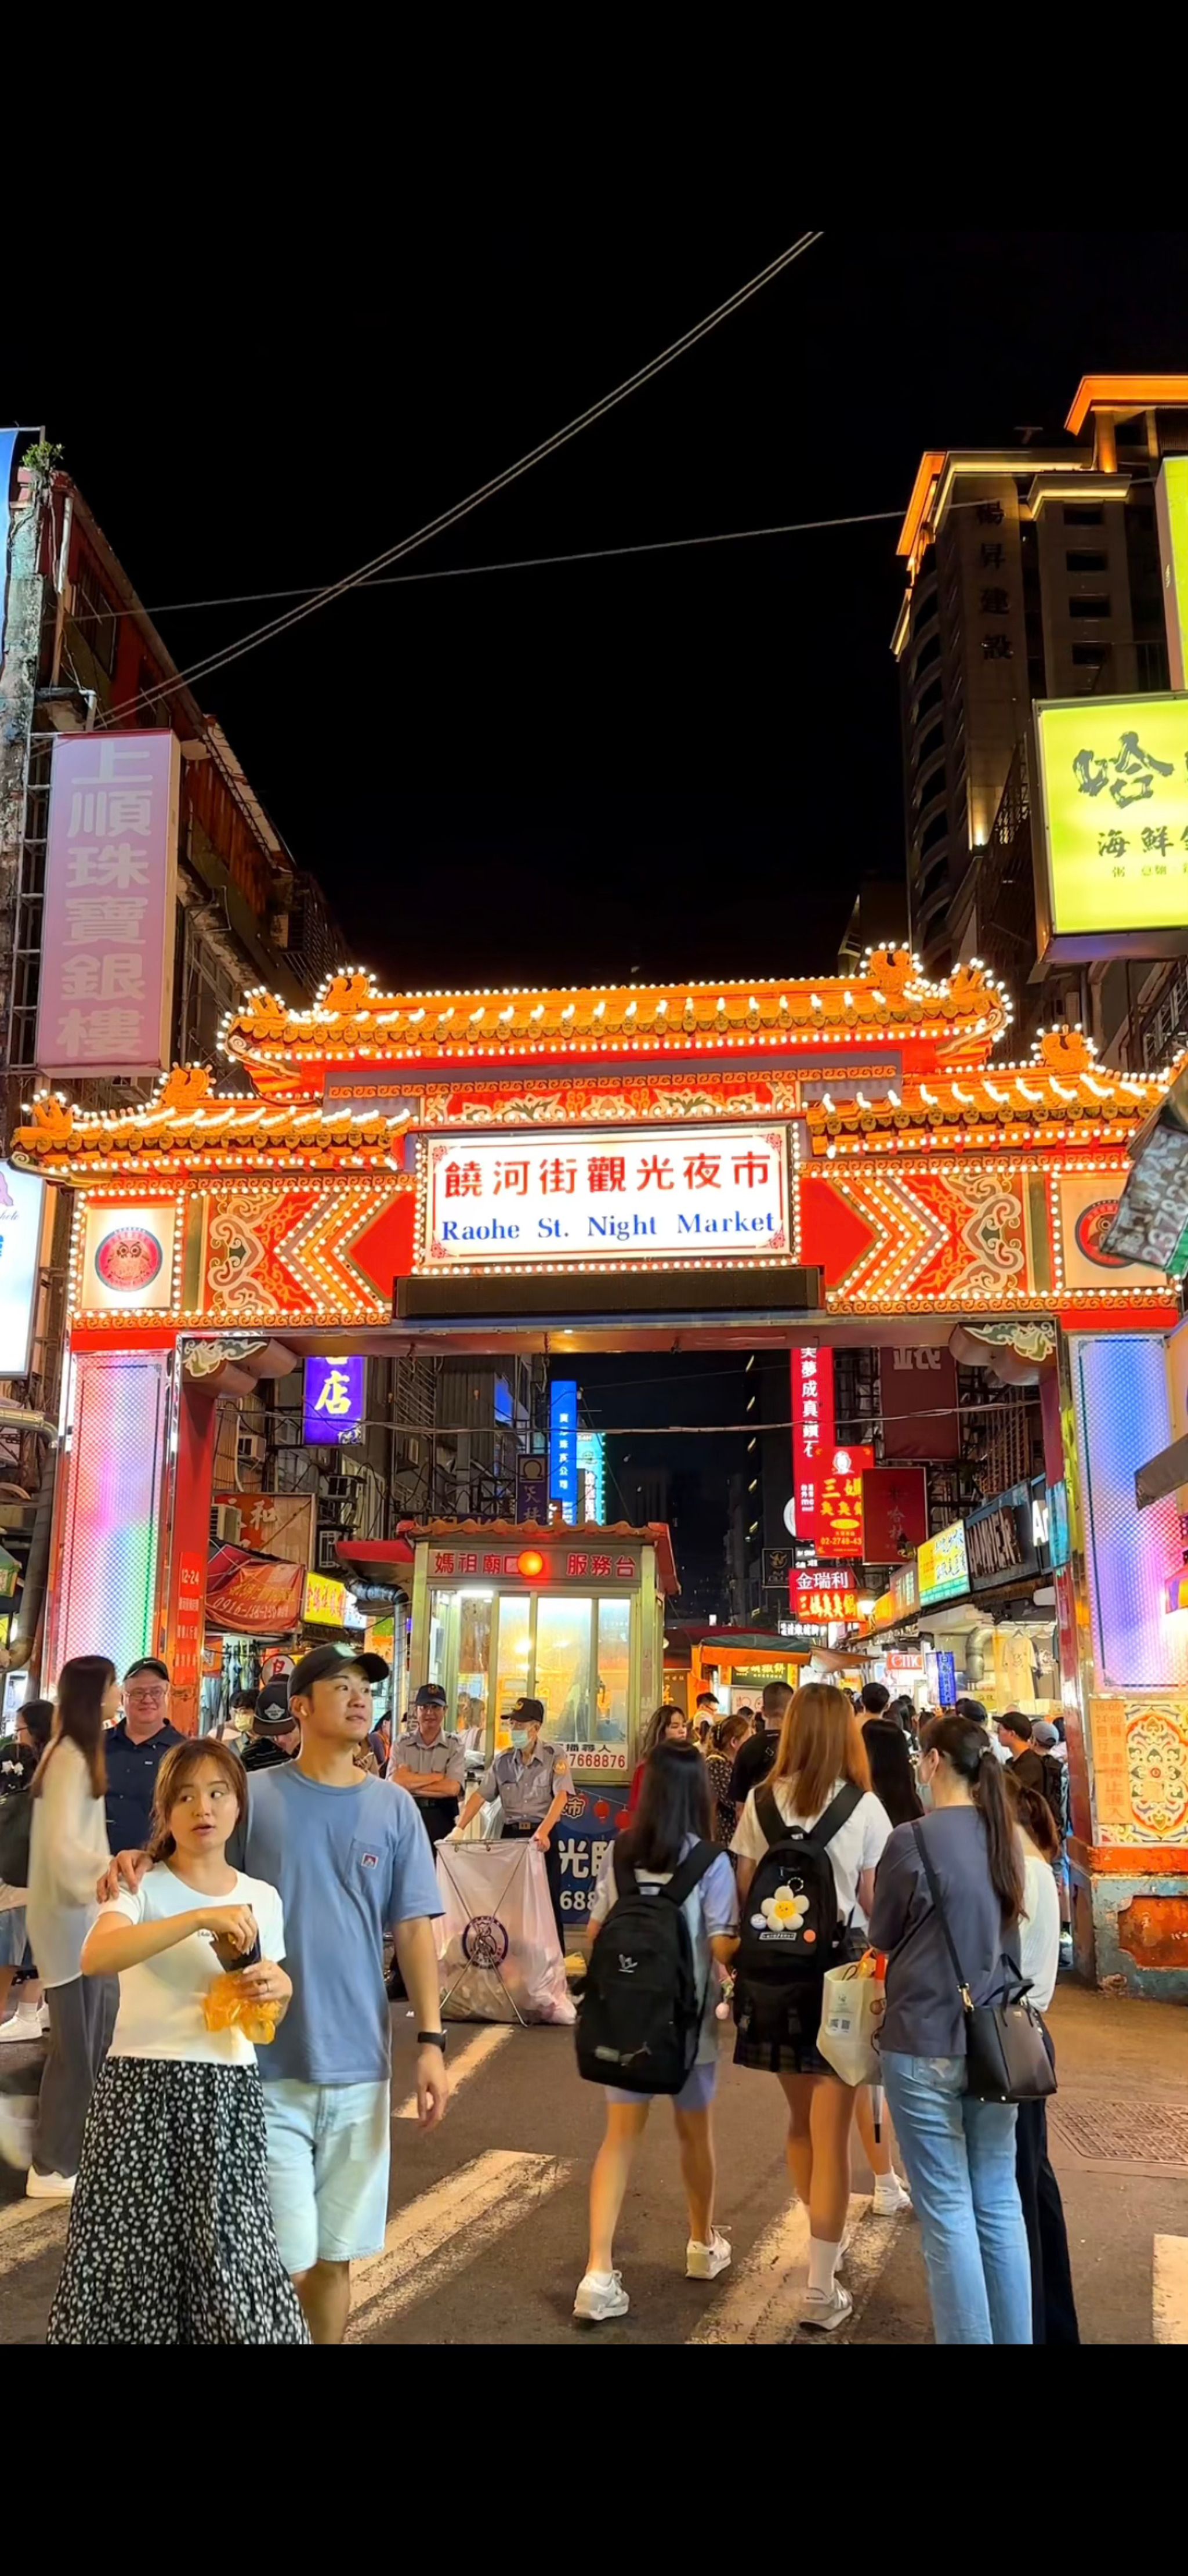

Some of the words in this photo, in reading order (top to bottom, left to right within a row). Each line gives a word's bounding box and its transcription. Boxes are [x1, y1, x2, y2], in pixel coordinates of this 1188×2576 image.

[1073, 731, 1188, 809] 哈
[57, 740, 153, 1058] 上順珠寶銀樓
[444, 1150, 770, 1198] 饒河街觀光夜市
[442, 1218, 520, 1240] Raohe
[538, 1217, 569, 1238] St.
[588, 1214, 657, 1241] Night
[678, 1211, 775, 1233] Market
[567, 1553, 635, 1578] 服務台
[796, 1572, 849, 1590] 金瑞利
[558, 1743, 611, 1753] 播尋人
